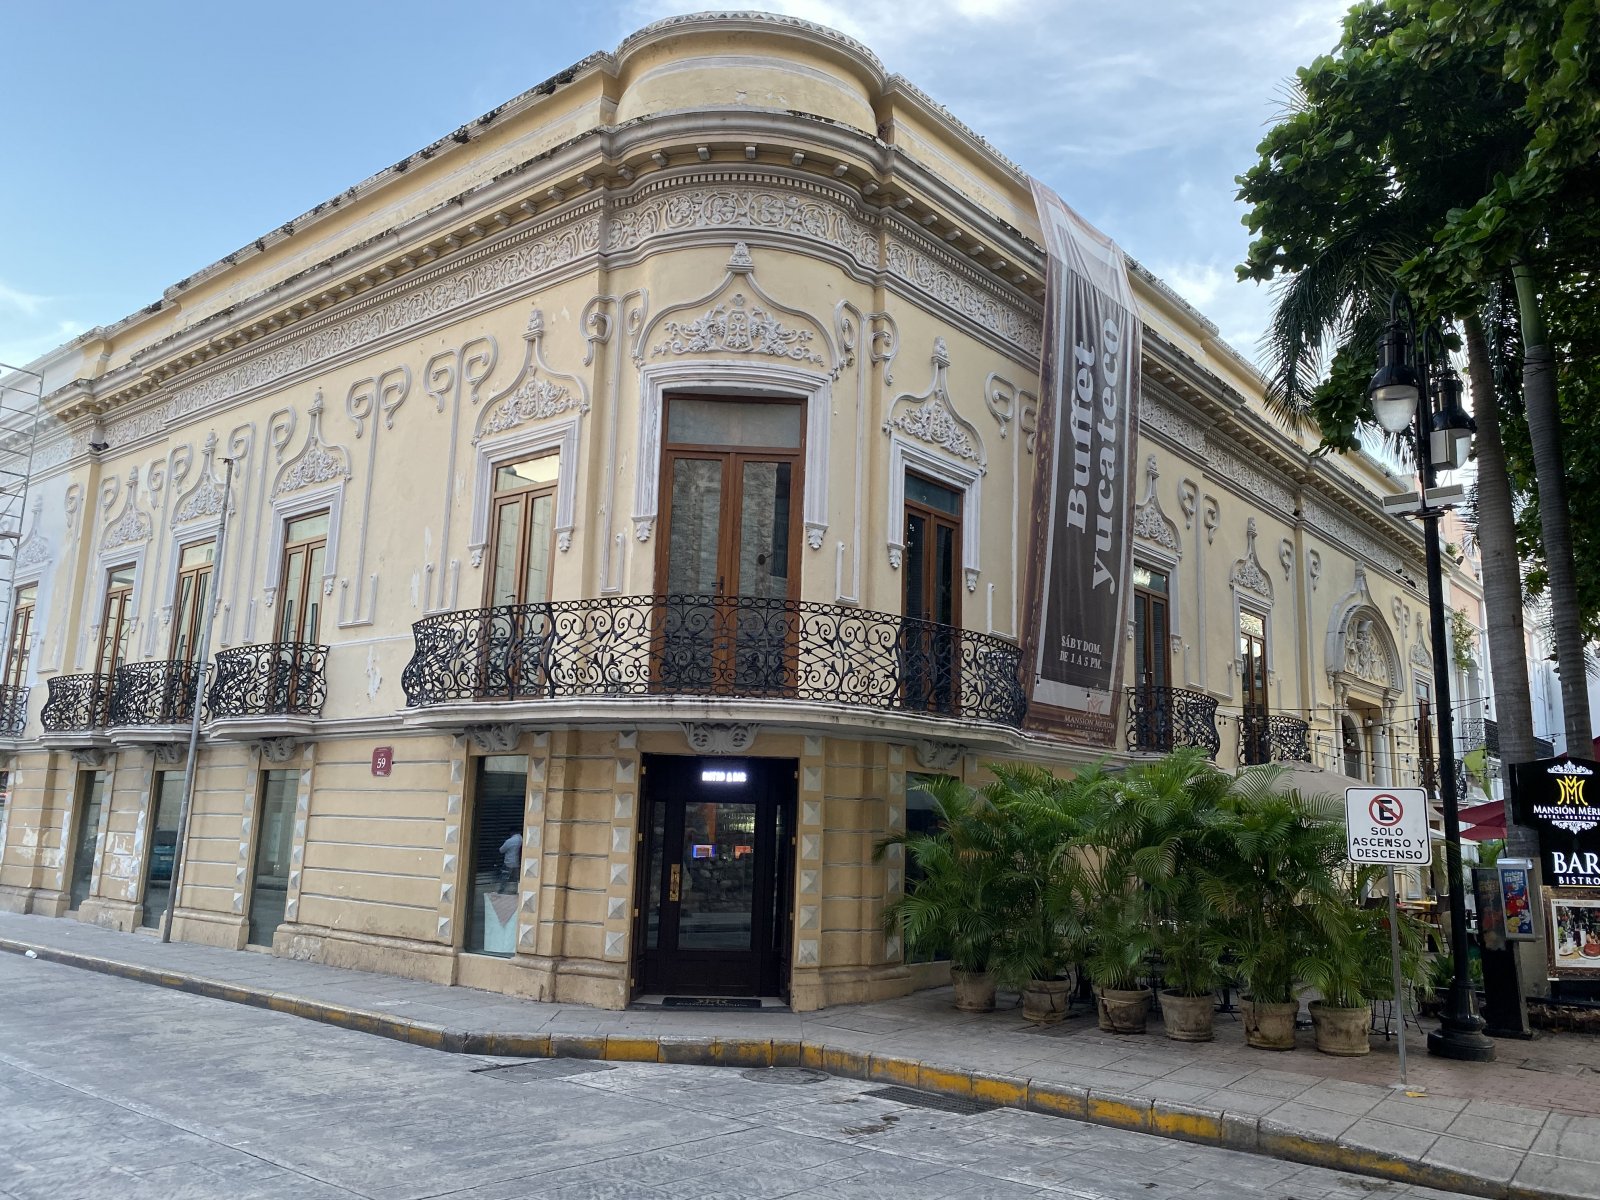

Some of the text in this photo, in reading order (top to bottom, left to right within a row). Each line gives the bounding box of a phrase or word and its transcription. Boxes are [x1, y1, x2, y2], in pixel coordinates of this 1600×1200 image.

[1066, 341, 1096, 534] Buffet
[1092, 318, 1120, 594] yucateco
[1060, 650, 1102, 670] DE 1 A 5 PM.
[376, 757, 386, 769] 59
[1533, 804, 1600, 816] MANSIÓN MÉRI
[1371, 826, 1404, 837] SOLO
[1352, 837, 1425, 848] ASCENSO Y
[1357, 848, 1423, 860] DESCENSO
[1551, 851, 1600, 875] BAR
[1558, 876, 1600, 885] BISTRO
